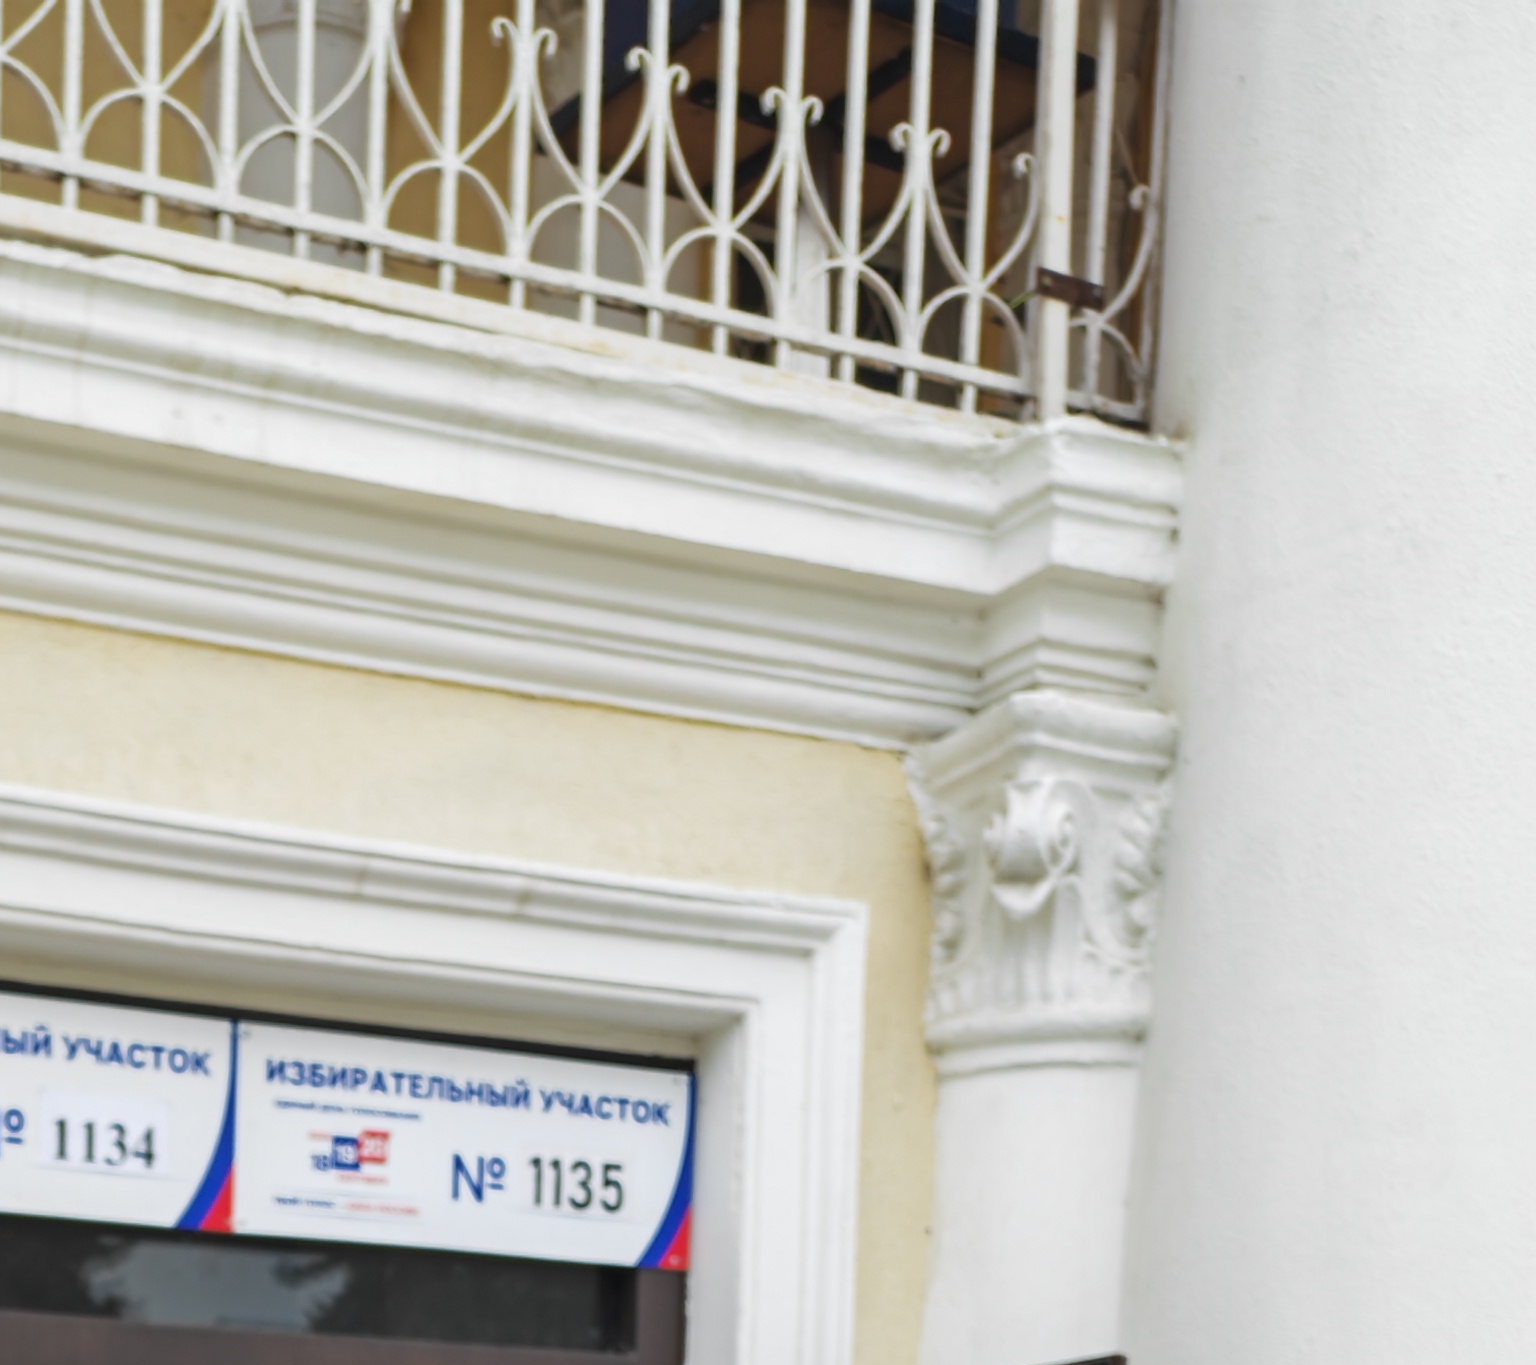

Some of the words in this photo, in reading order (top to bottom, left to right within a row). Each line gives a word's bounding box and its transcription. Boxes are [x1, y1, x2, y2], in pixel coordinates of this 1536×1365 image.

[62, 1034, 212, 1076] УЧАСТОК
[265, 1058, 531, 1108] ИЗБИРАТЕЛЬНЫЙ
[539, 1088, 671, 1128] УЧАСТОК
[55, 1118, 156, 1168] 1134
[451, 1153, 507, 1204] №
[529, 1156, 624, 1214] 1135
